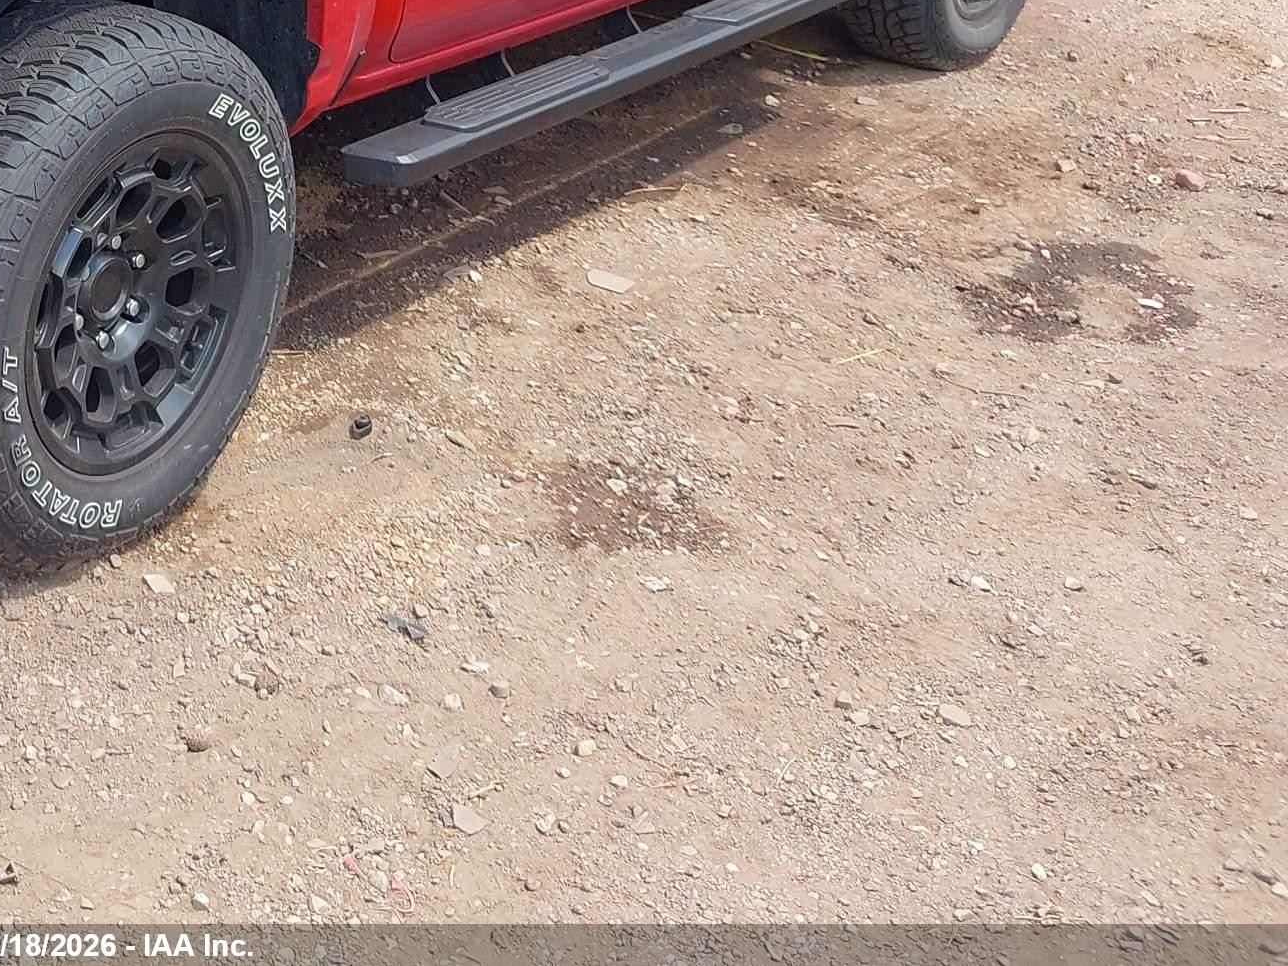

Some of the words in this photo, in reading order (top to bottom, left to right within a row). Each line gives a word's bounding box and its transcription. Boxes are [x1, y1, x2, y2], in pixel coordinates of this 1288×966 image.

[208, 93, 287, 233] EVOLUXX
[2, 345, 22, 424] A/T
[12, 434, 123, 528] ROTATOR
